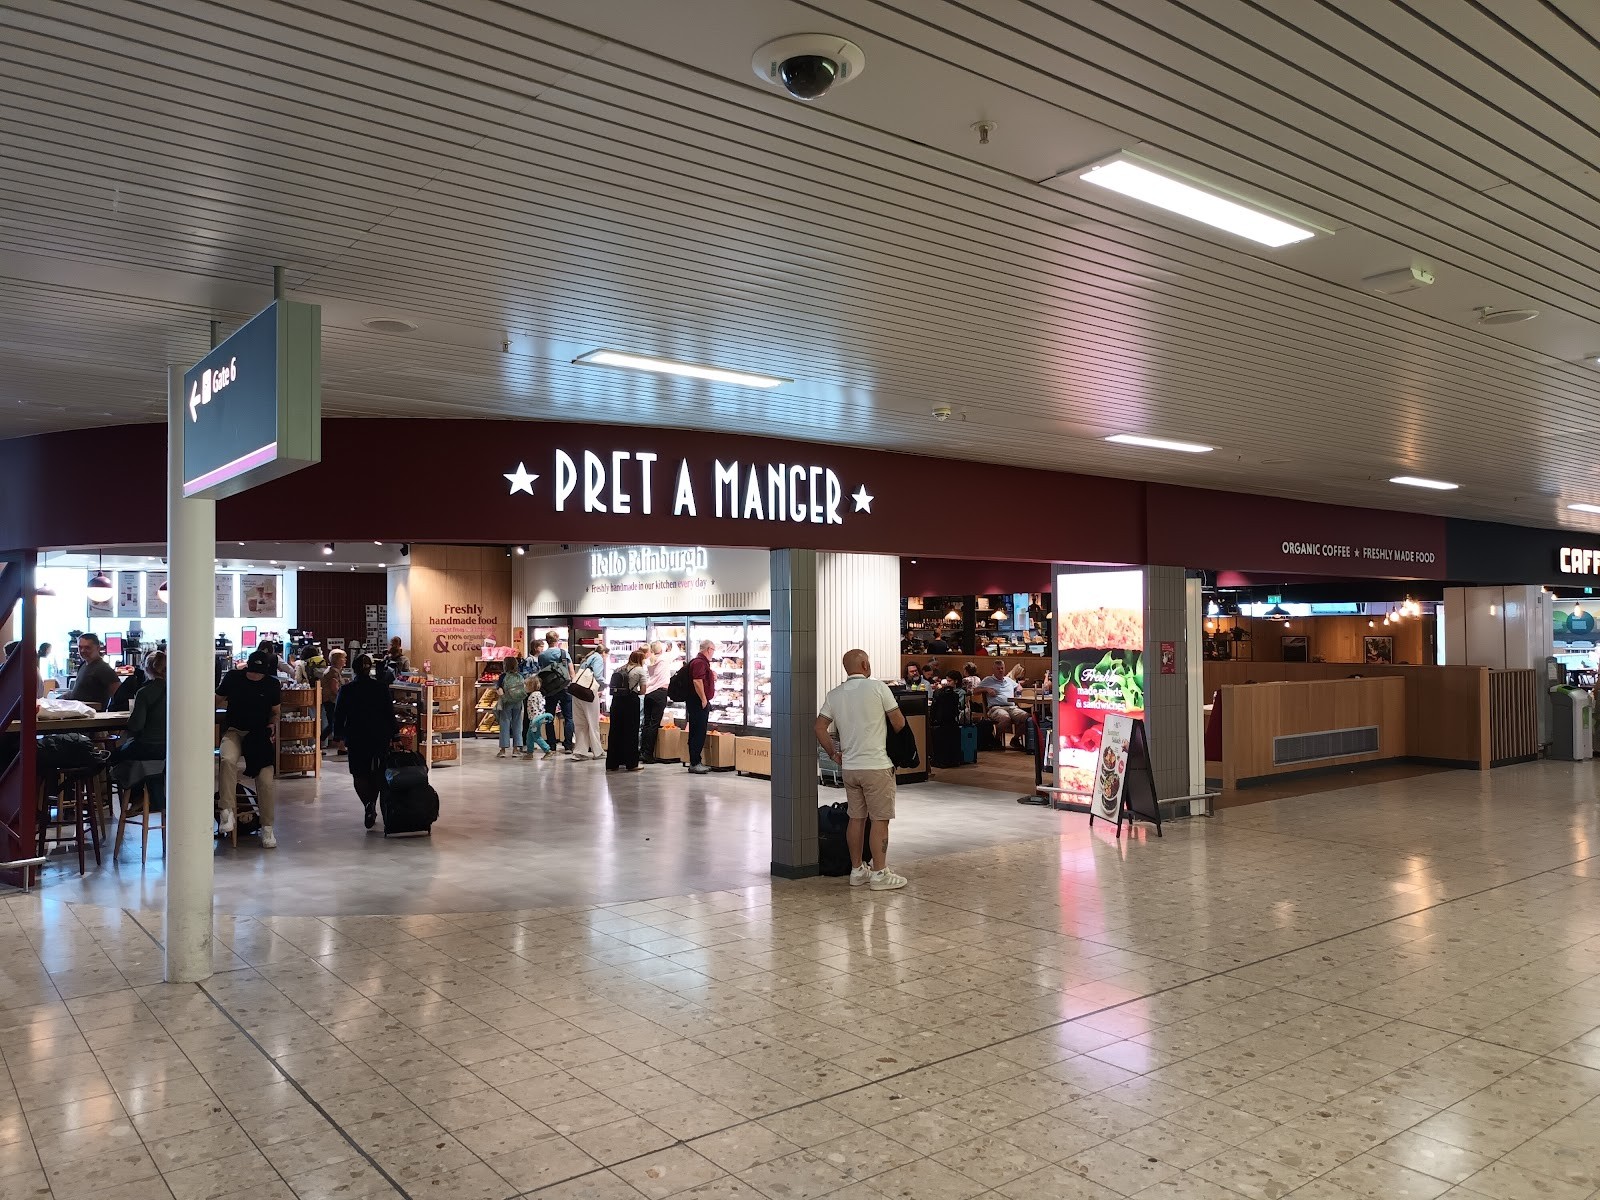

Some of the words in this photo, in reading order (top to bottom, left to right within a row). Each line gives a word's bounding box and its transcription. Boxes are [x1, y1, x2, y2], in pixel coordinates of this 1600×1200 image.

[212, 367, 230, 393] Gate
[230, 357, 236, 381] 6
[554, 448, 658, 515] PRET
[672, 457, 698, 517] A
[714, 458, 843, 525] MANGER
[1281, 541, 1321, 556] ORGANIC
[1322, 544, 1351, 558] COFFEE
[1363, 547, 1393, 561] FRESHLY
[1394, 550, 1415, 562] MADE
[1415, 551, 1435, 563] FOOD
[590, 551, 627, 578] Hello
[627, 546, 708, 576] Edinburgh
[591, 584, 609, 594] Freshly
[610, 581, 638, 592] handmade
[638, 581, 644, 590] in
[644, 581, 654, 590] our
[655, 577, 677, 589] kitchen
[677, 579, 693, 589] every
[694, 577, 707, 589] day
[444, 604, 483, 616] Freshly
[429, 617, 477, 625] handmade
[478, 617, 497, 625] food
[433, 635, 450, 652] &
[451, 641, 482, 652] coffee
[1077, 687, 1098, 696] made
[1098, 687, 1123, 697] salads
[1076, 699, 1082, 708] &
[1082, 699, 1126, 710] sandwiches
